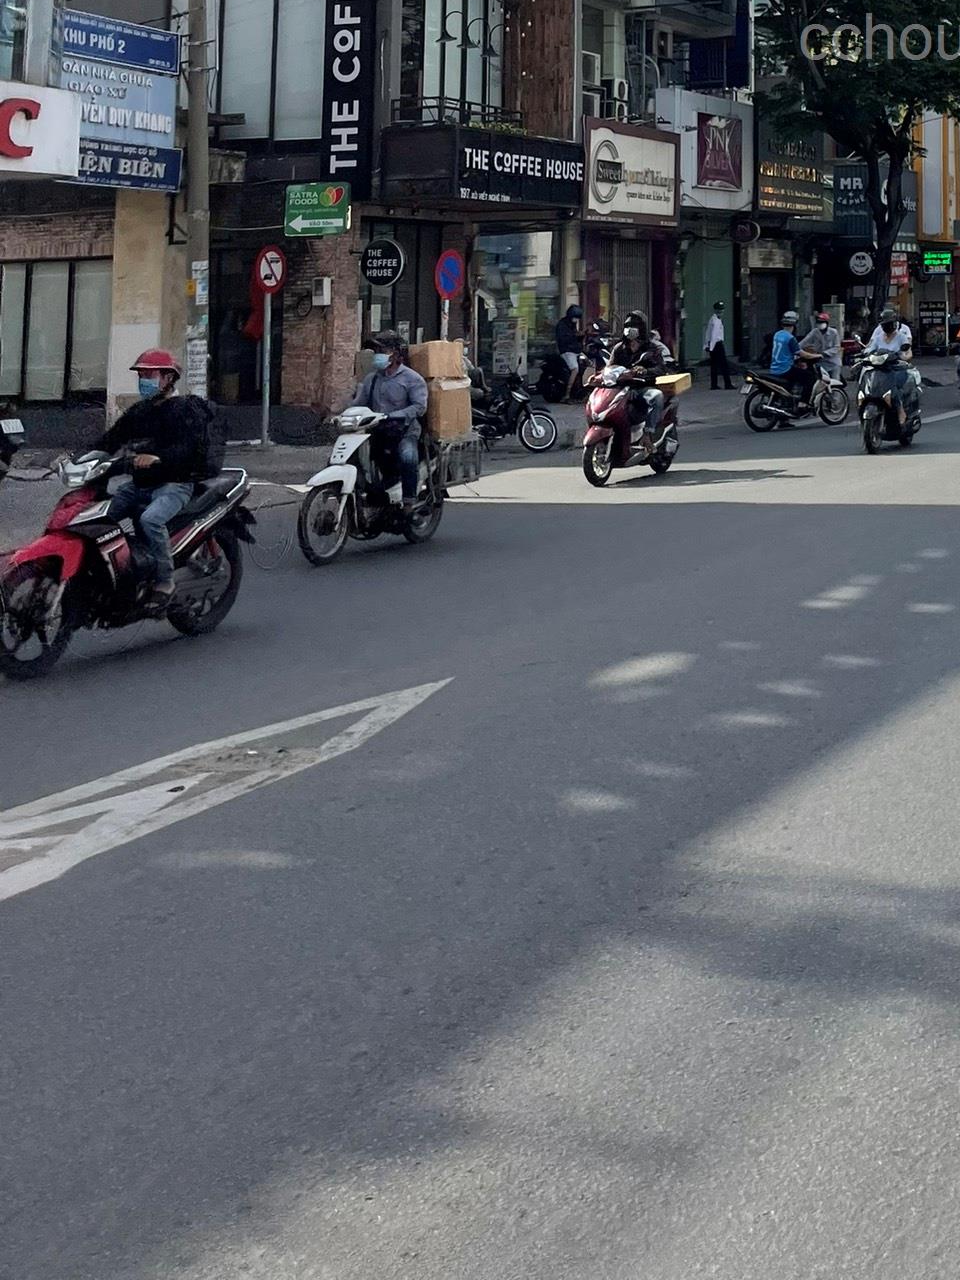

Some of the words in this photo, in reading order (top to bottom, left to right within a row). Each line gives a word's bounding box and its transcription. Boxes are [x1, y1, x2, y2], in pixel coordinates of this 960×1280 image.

[90, 31, 115, 51] PHỐ
[118, 40, 126, 54] 2
[329, 100, 360, 174] THE
[79, 150, 113, 175] IỆN
[118, 156, 166, 179] BIÊN
[464, 147, 489, 171] THE
[494, 151, 542, 177] COFFEE
[546, 159, 584, 181] HOUSE
[840, 177, 863, 190] MR
[289, 191, 319, 200] SATRA
[289, 198, 319, 206] FOODS
[367, 249, 382, 257] THE
[367, 258, 398, 268] COFFEE
[367, 268, 393, 277] HOUSE
